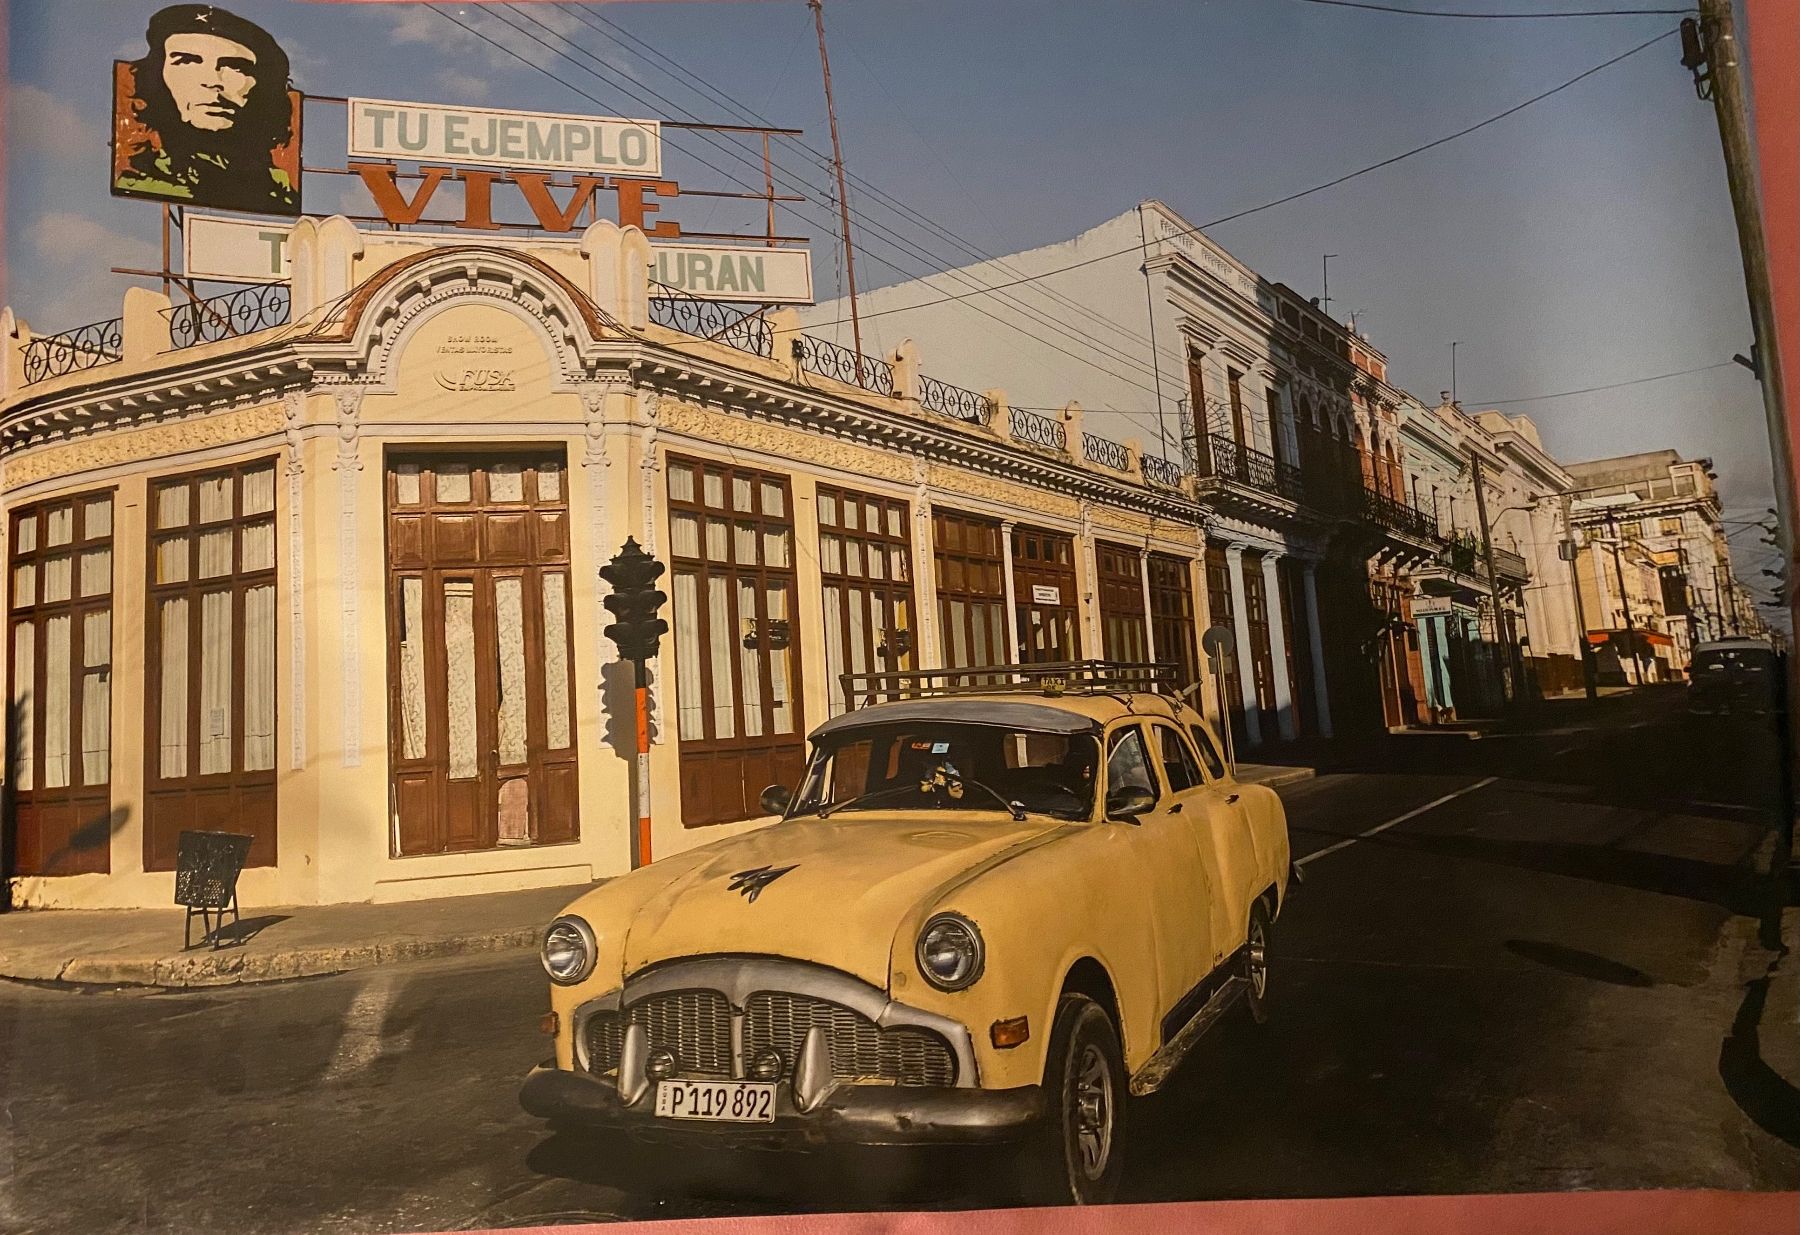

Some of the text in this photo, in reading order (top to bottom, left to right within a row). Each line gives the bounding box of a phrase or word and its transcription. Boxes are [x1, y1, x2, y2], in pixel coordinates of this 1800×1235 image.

[363, 107, 649, 167] TU EJEMPLO
[347, 161, 679, 238] VIVE
[1043, 676, 1065, 686] TAXI
[671, 1086, 772, 1118] P 119 892
